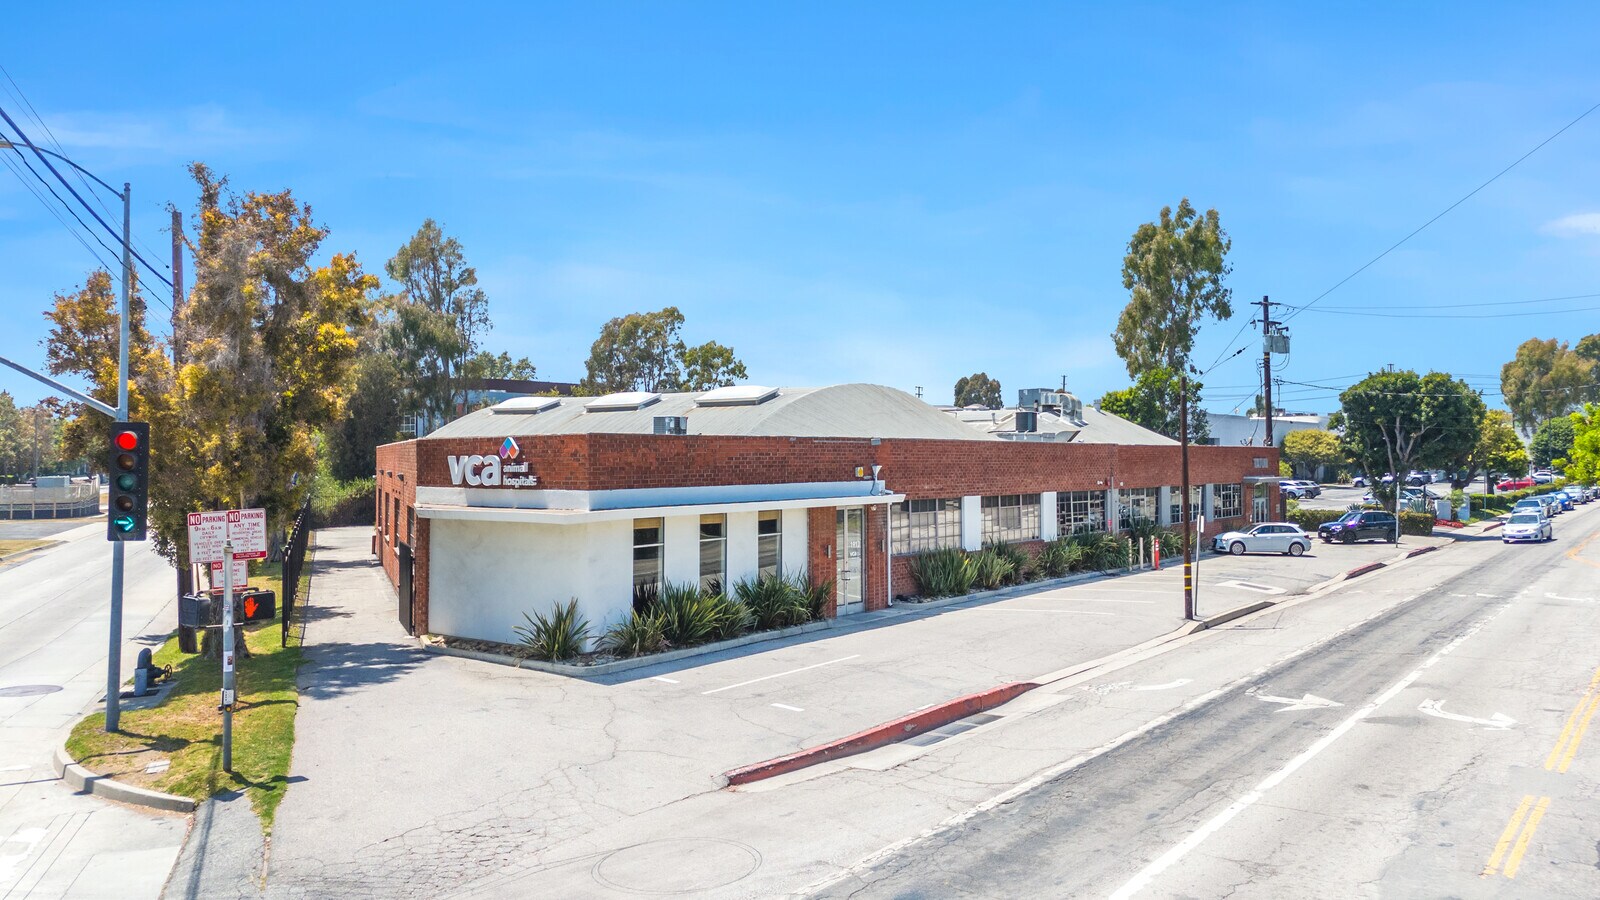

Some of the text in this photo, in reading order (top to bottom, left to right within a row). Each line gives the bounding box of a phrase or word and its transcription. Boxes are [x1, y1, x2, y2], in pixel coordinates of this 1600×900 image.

[447, 455, 501, 486] vca
[503, 462, 528, 472] animal
[190, 515, 225, 525] NO PARKING
[229, 512, 240, 522] NO
